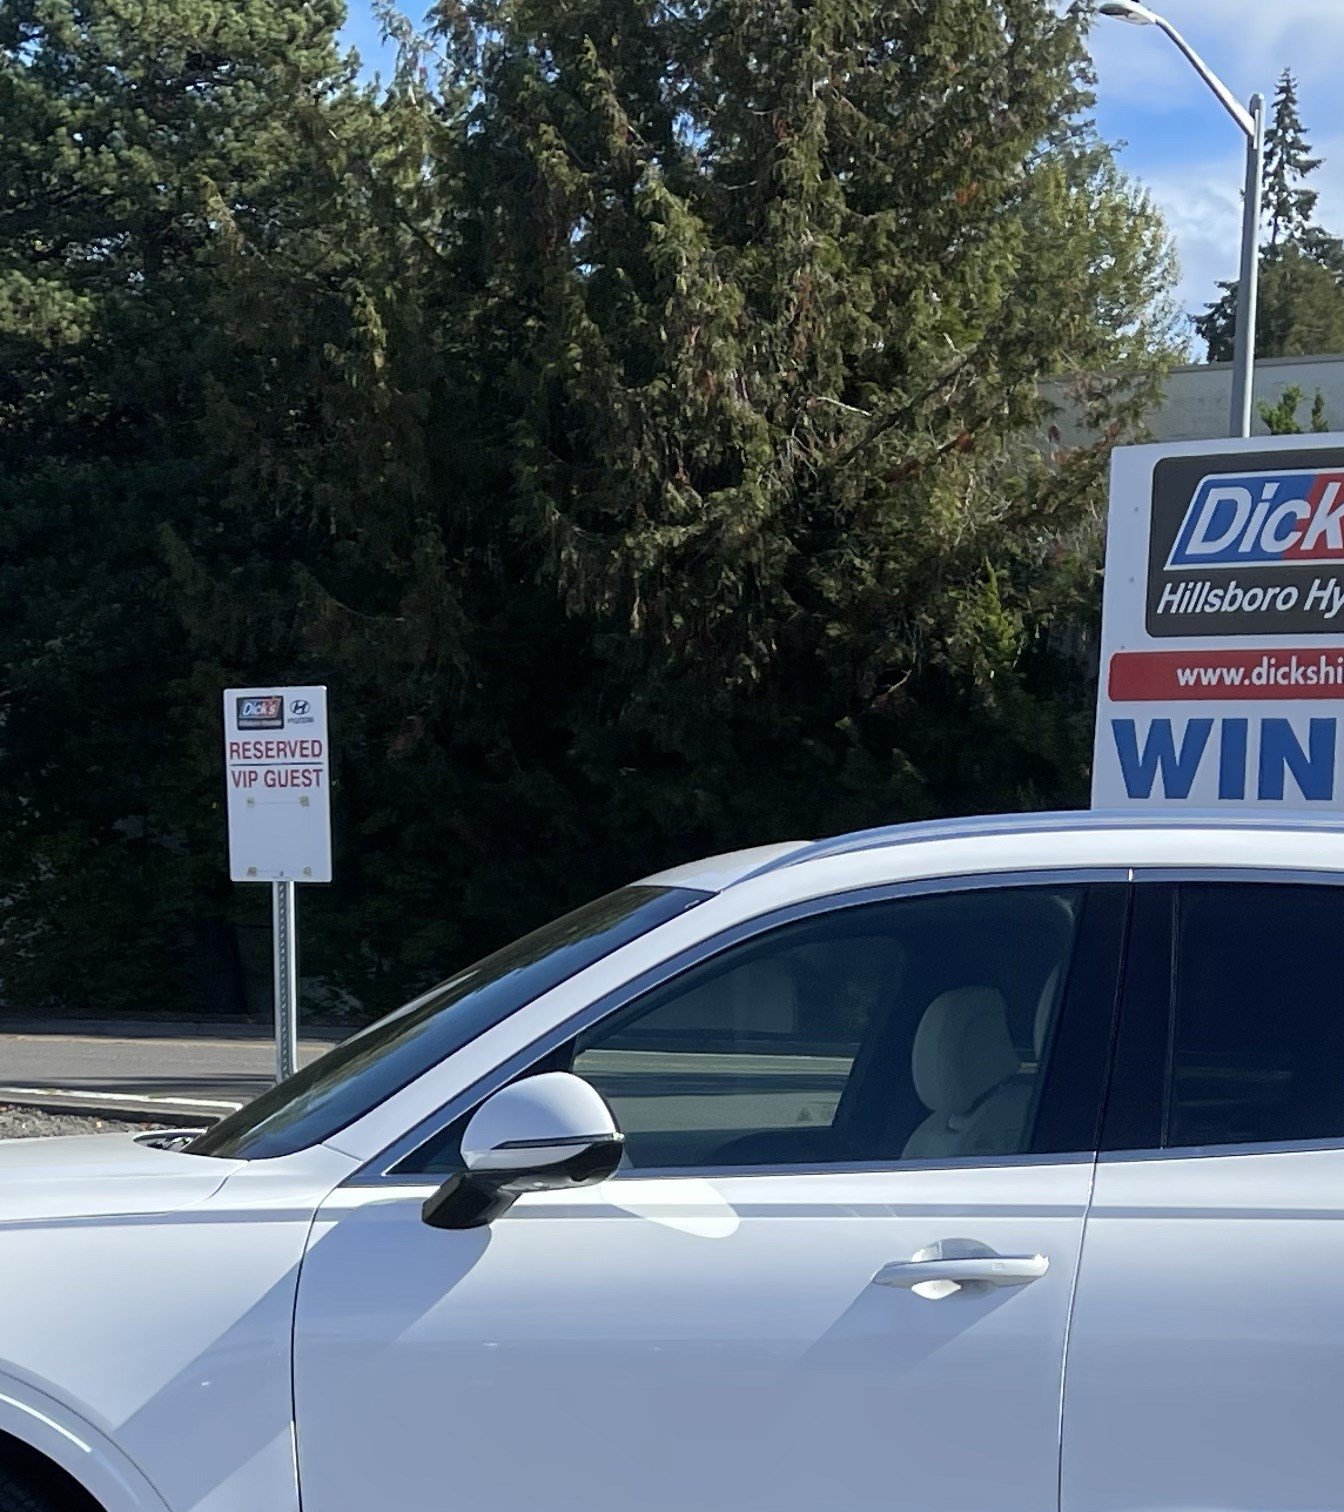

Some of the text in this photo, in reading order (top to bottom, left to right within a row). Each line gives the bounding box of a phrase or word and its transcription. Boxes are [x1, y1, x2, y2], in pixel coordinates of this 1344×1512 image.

[1157, 580, 1298, 615] Hillsboro
[229, 740, 323, 759] RESERVED
[231, 769, 324, 788] VIP GUEST
